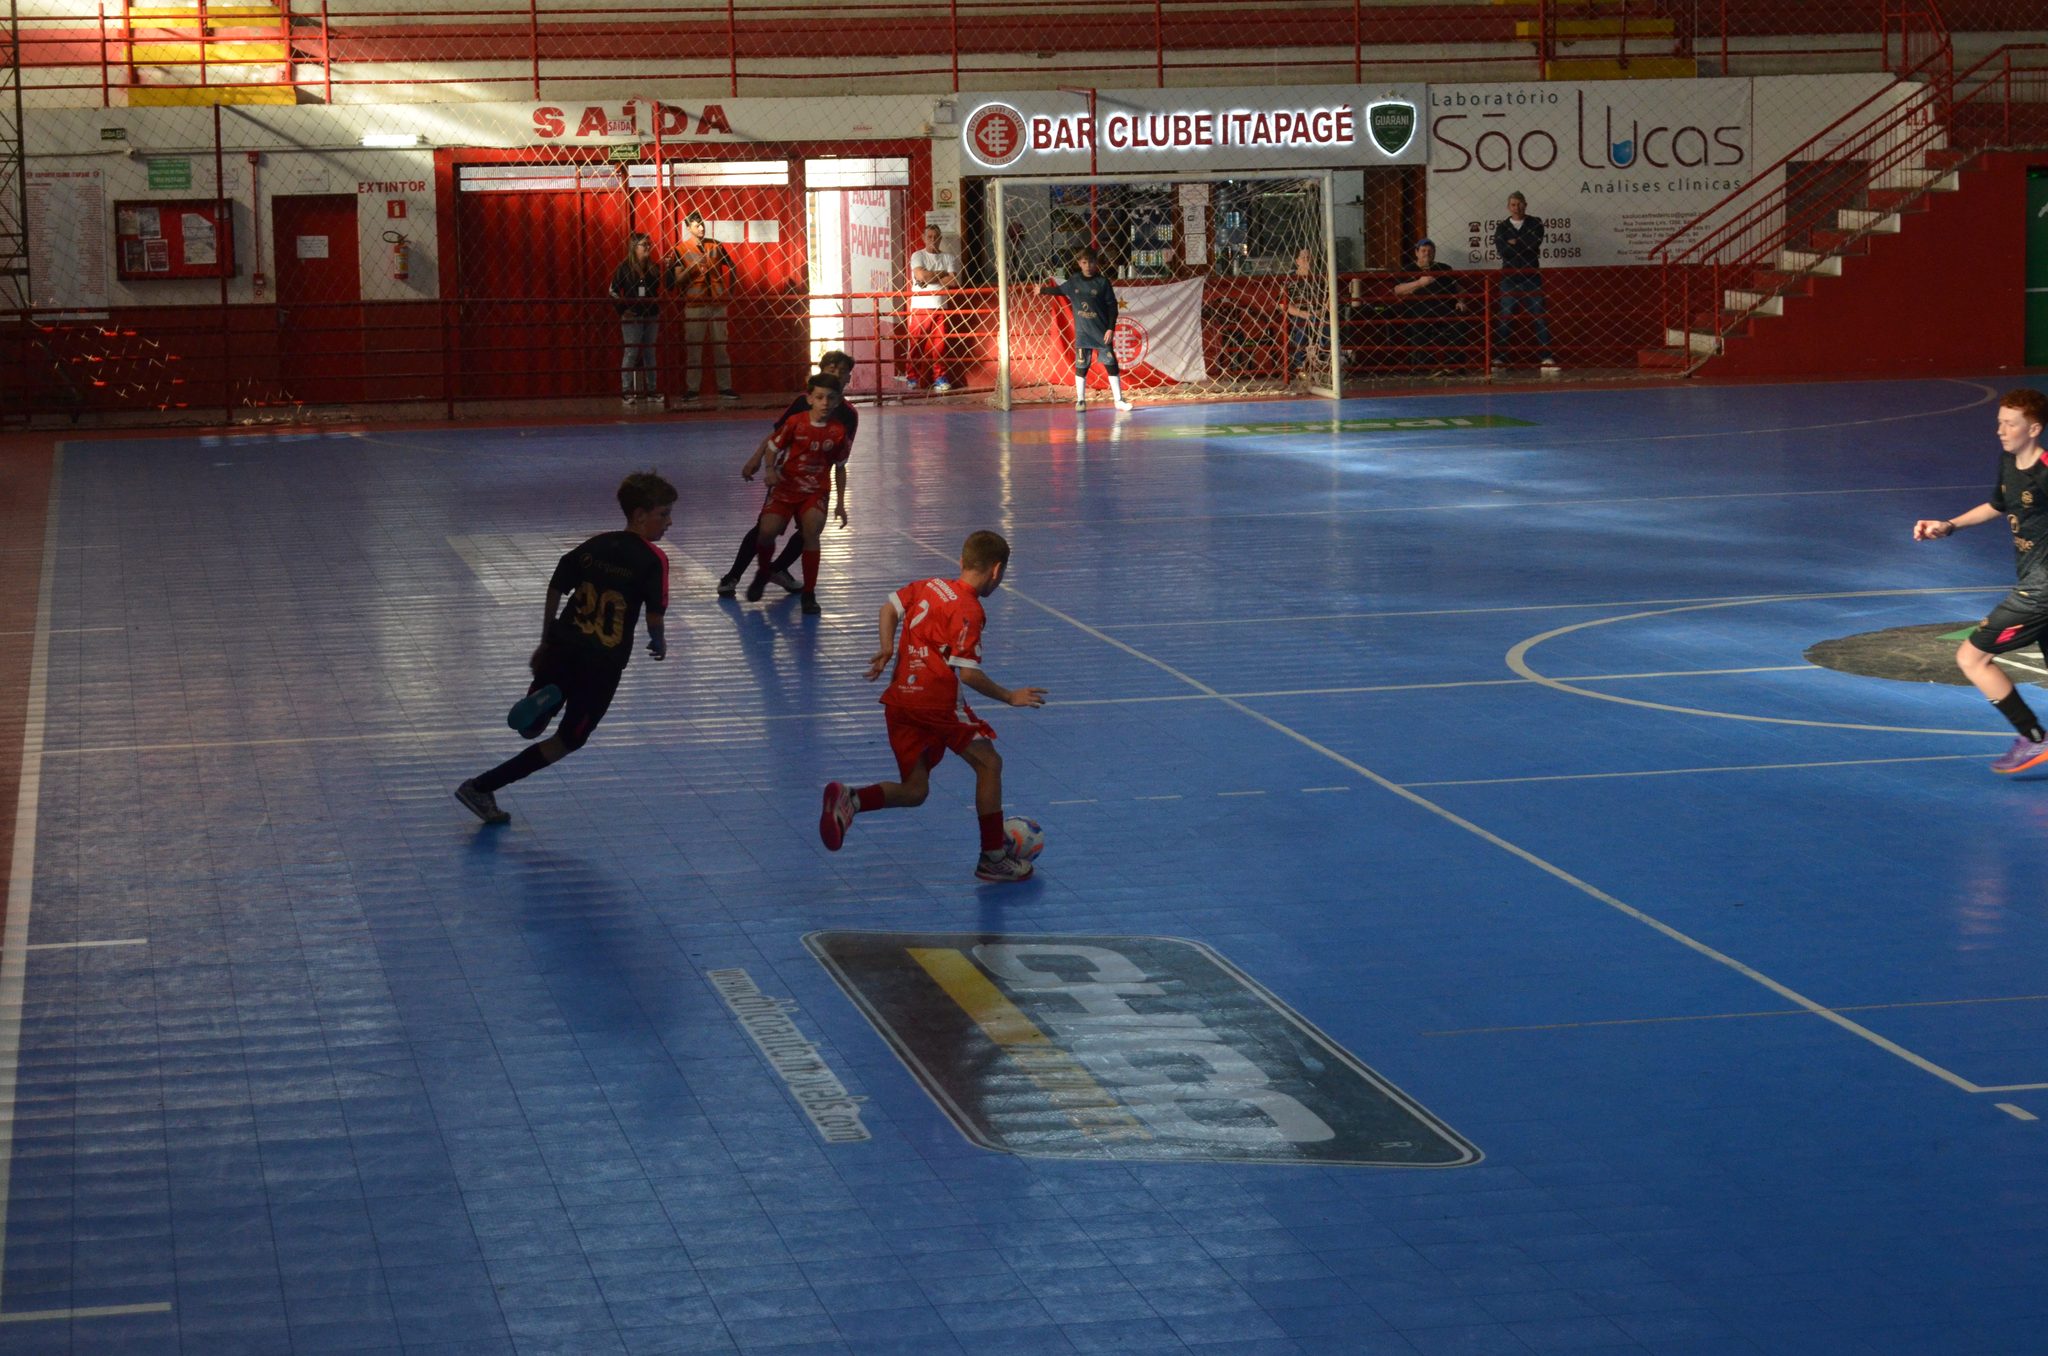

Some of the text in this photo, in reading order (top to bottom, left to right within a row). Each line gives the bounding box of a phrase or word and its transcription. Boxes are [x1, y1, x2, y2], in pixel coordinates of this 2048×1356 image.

[1432, 91, 1558, 106] Laboratório
[532, 101, 733, 138] SAÍDA
[608, 120, 631, 132] SAÍDA
[1033, 105, 1354, 150] BAR CLUBE ITAPAGÉ
[1375, 114, 1409, 126] GUARANI
[1433, 89, 1744, 173] São Lucas
[358, 181, 426, 194] EXTINTOR
[1581, 177, 1741, 194] Análises clínicas
[971, 943, 1336, 1143] CHICO
